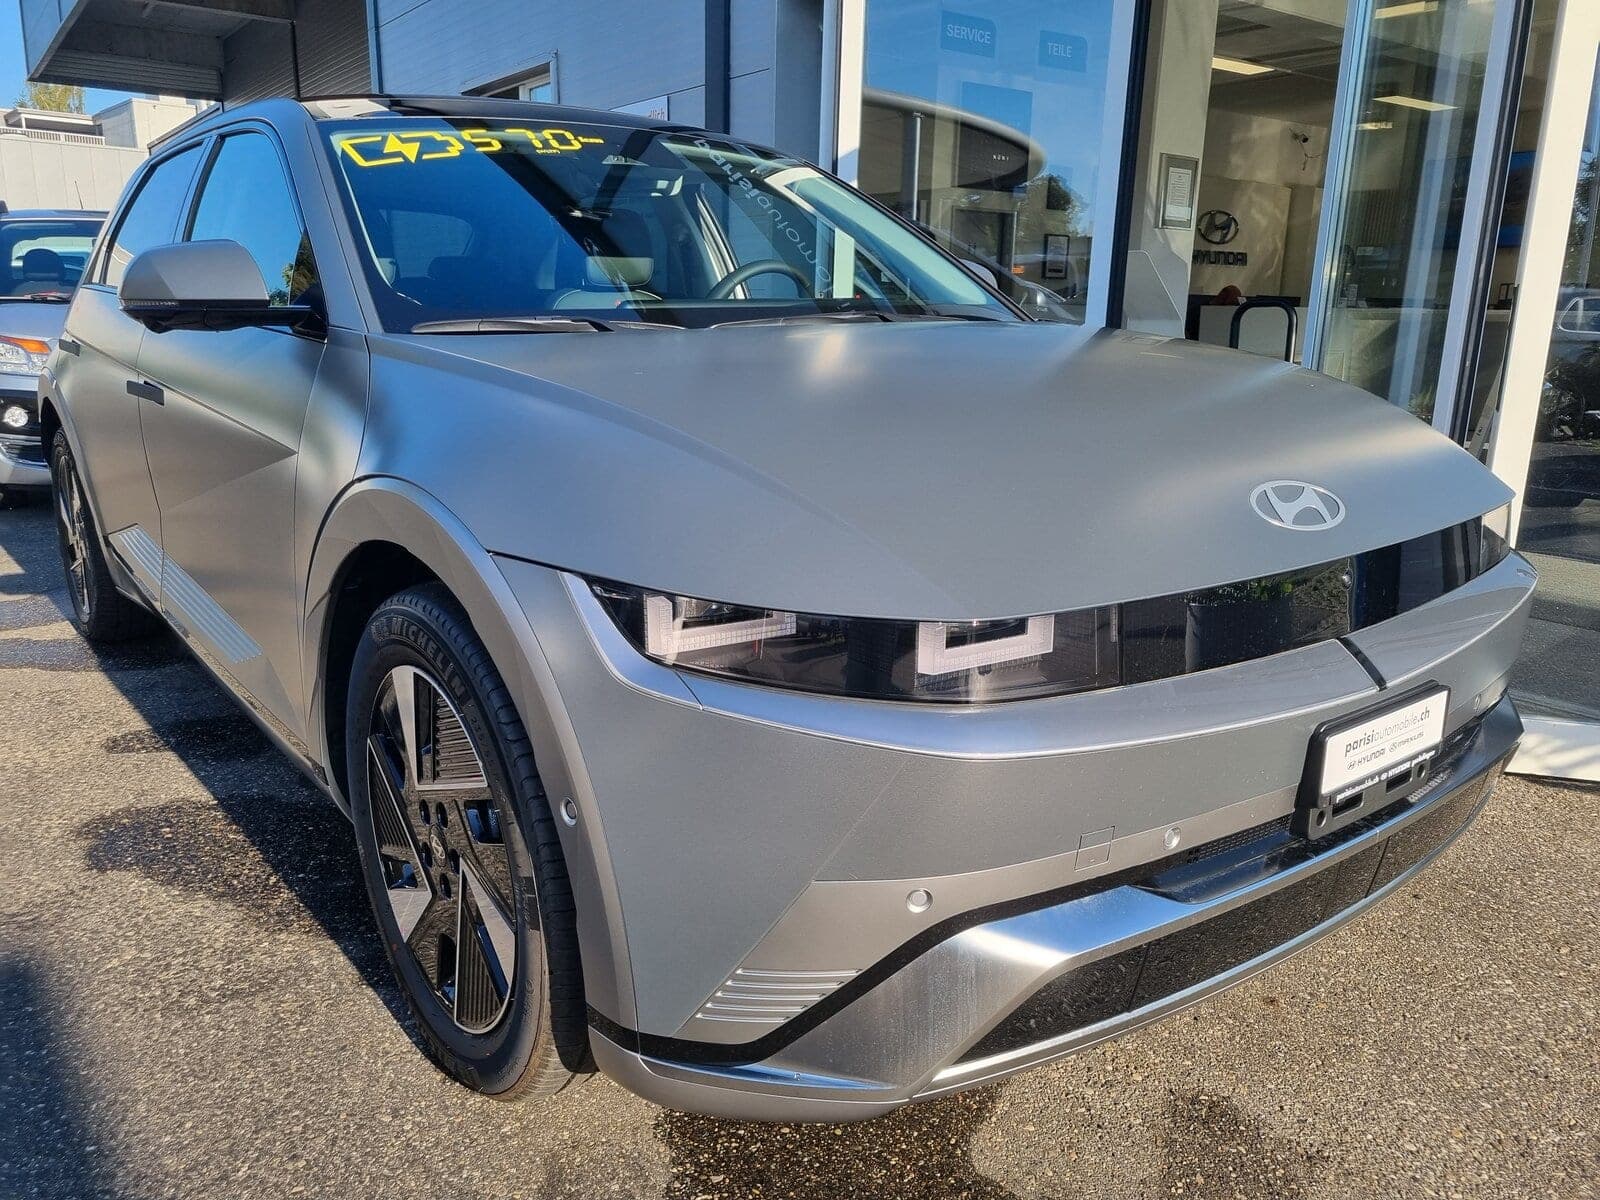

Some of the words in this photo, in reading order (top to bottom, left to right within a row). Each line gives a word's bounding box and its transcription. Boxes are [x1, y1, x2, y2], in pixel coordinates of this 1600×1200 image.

[946, 24, 992, 45] SERVICE
[1047, 42, 1073, 58] TEILE
[460, 128, 580, 152] 570
[1191, 249, 1248, 267] HYUNDAI
[391, 616, 469, 699] MICHELIN
[1344, 705, 1431, 758] parisiautomobile.ch
[1357, 747, 1387, 767] HYUNDAI
